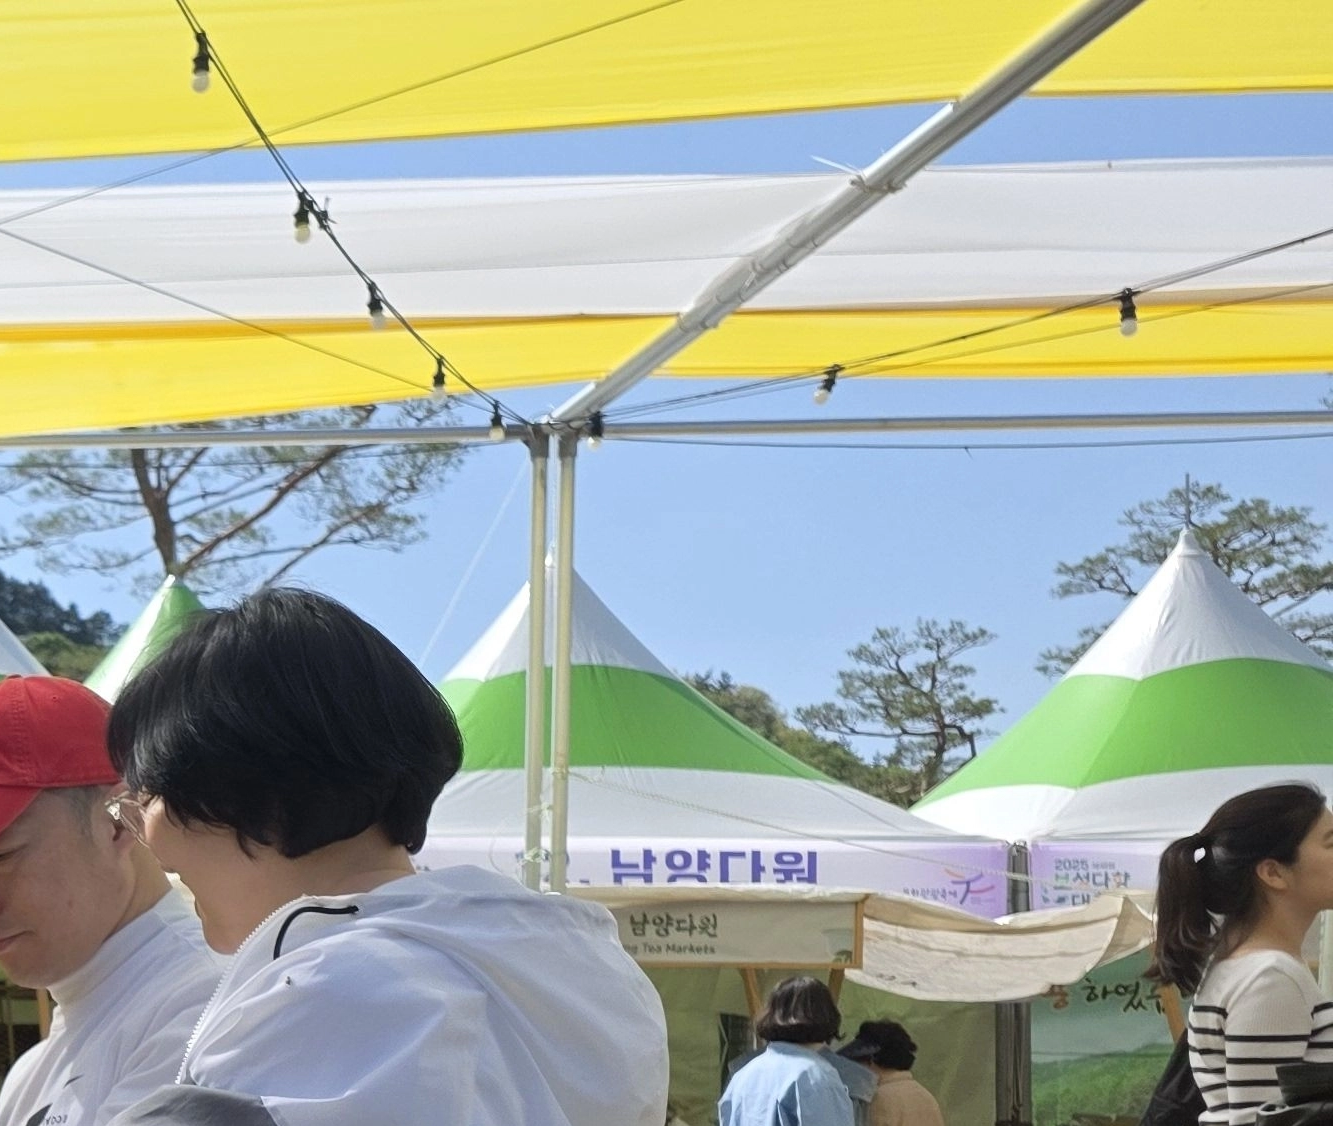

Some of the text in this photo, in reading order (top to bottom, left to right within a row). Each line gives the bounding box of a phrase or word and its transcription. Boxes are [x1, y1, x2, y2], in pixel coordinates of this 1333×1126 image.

[610, 848, 818, 884] 남양다원
[1055, 860, 1089, 871] 2025
[630, 911, 718, 938] 남양다원
